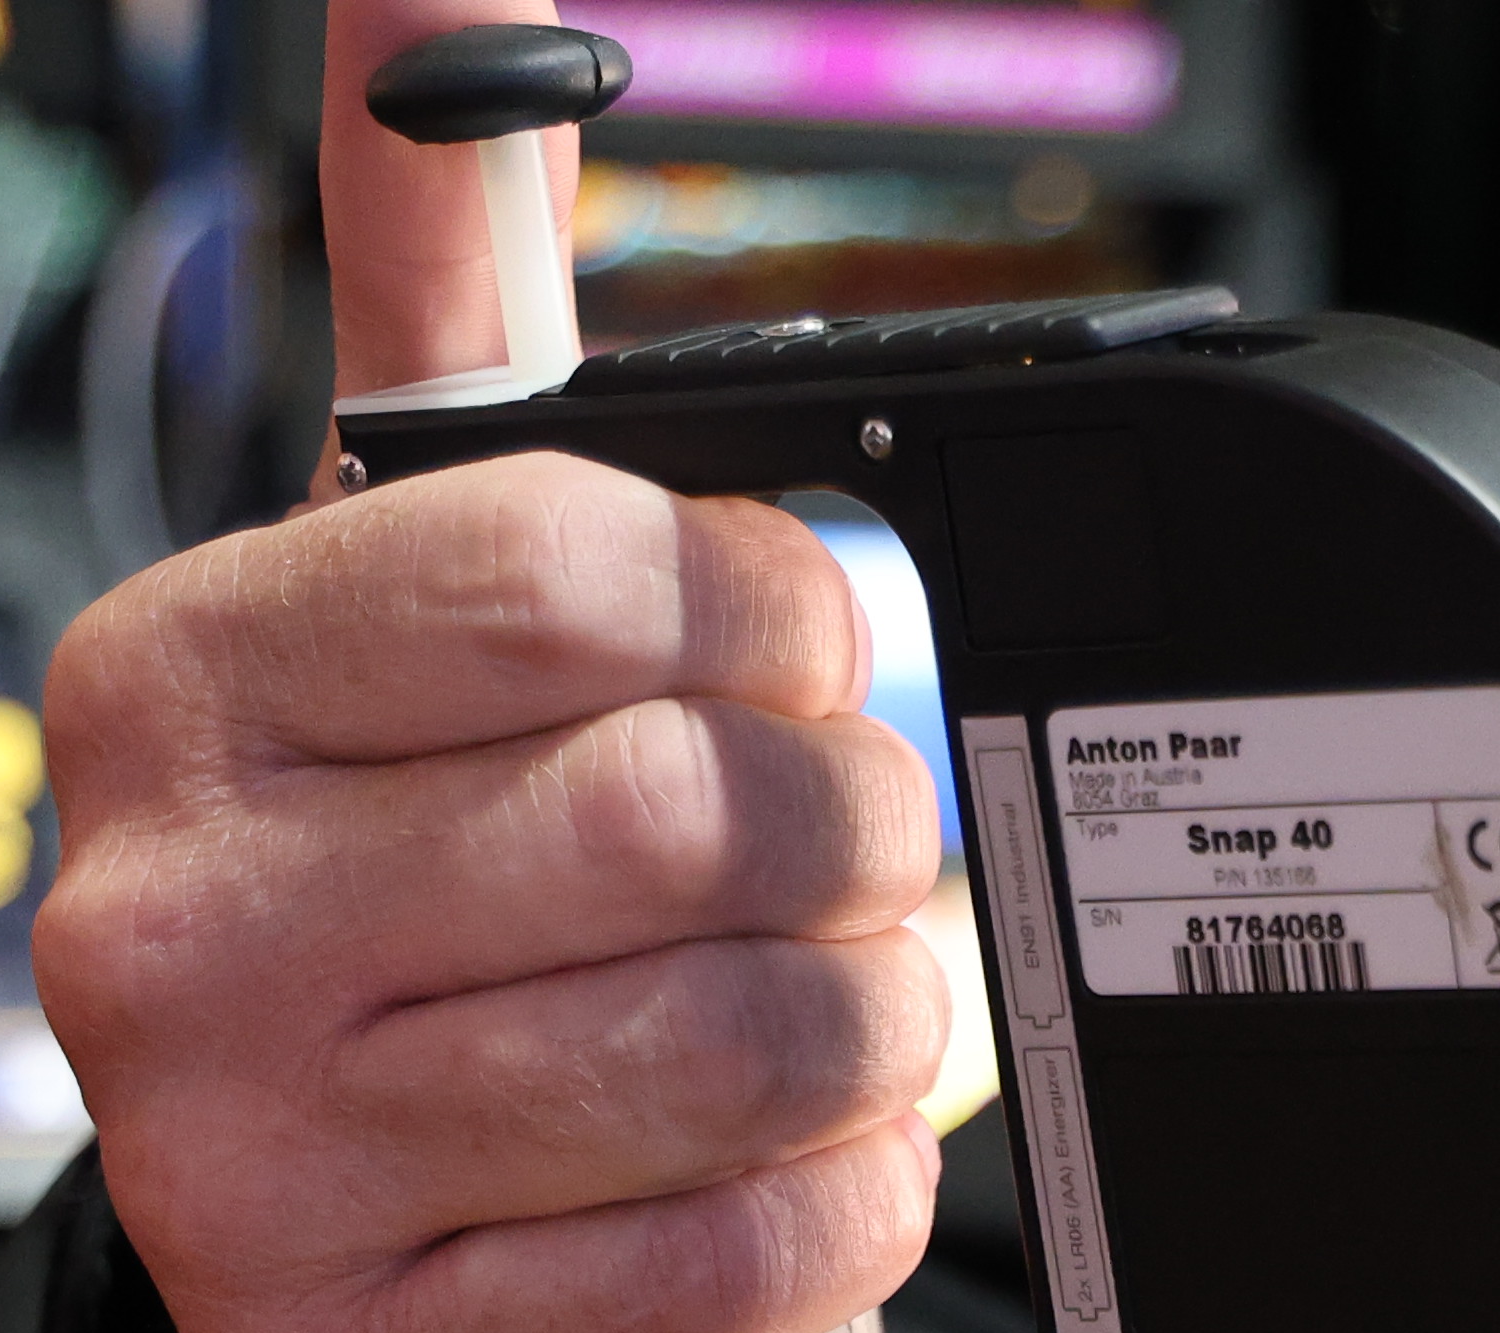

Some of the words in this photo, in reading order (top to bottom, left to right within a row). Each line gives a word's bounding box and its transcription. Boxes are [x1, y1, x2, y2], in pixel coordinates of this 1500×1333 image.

[1067, 736, 1158, 765] Anton
[1169, 732, 1242, 761] Paar
[1076, 818, 1119, 842] Type
[1187, 823, 1278, 861] Snap
[1290, 819, 1334, 851] 40
[1001, 802, 1030, 905] Industrial
[1089, 906, 1123, 928] S/N
[1186, 912, 1346, 944] 81764068
[1019, 912, 1041, 969] EN91
[1043, 1055, 1071, 1159] Energizer
[1058, 1164, 1080, 1209] (AA)
[1077, 1277, 1094, 1303] 2x
